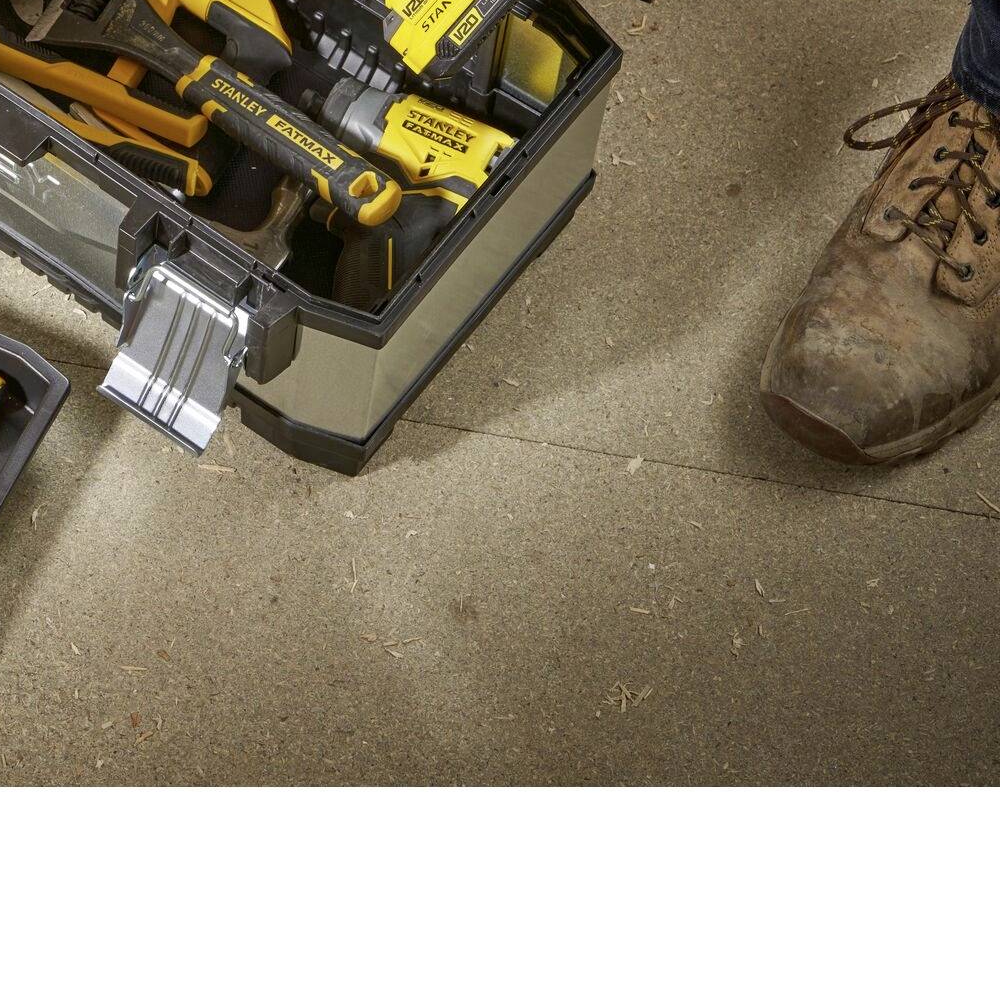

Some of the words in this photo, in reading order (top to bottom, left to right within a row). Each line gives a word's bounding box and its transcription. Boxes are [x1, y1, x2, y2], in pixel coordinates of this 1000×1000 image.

[453, 13, 479, 42] V20
[211, 78, 267, 118] STANLEY
[274, 119, 337, 166] FATMAX
[404, 122, 466, 153] FATMAX
[406, 109, 478, 143] STANLEY
